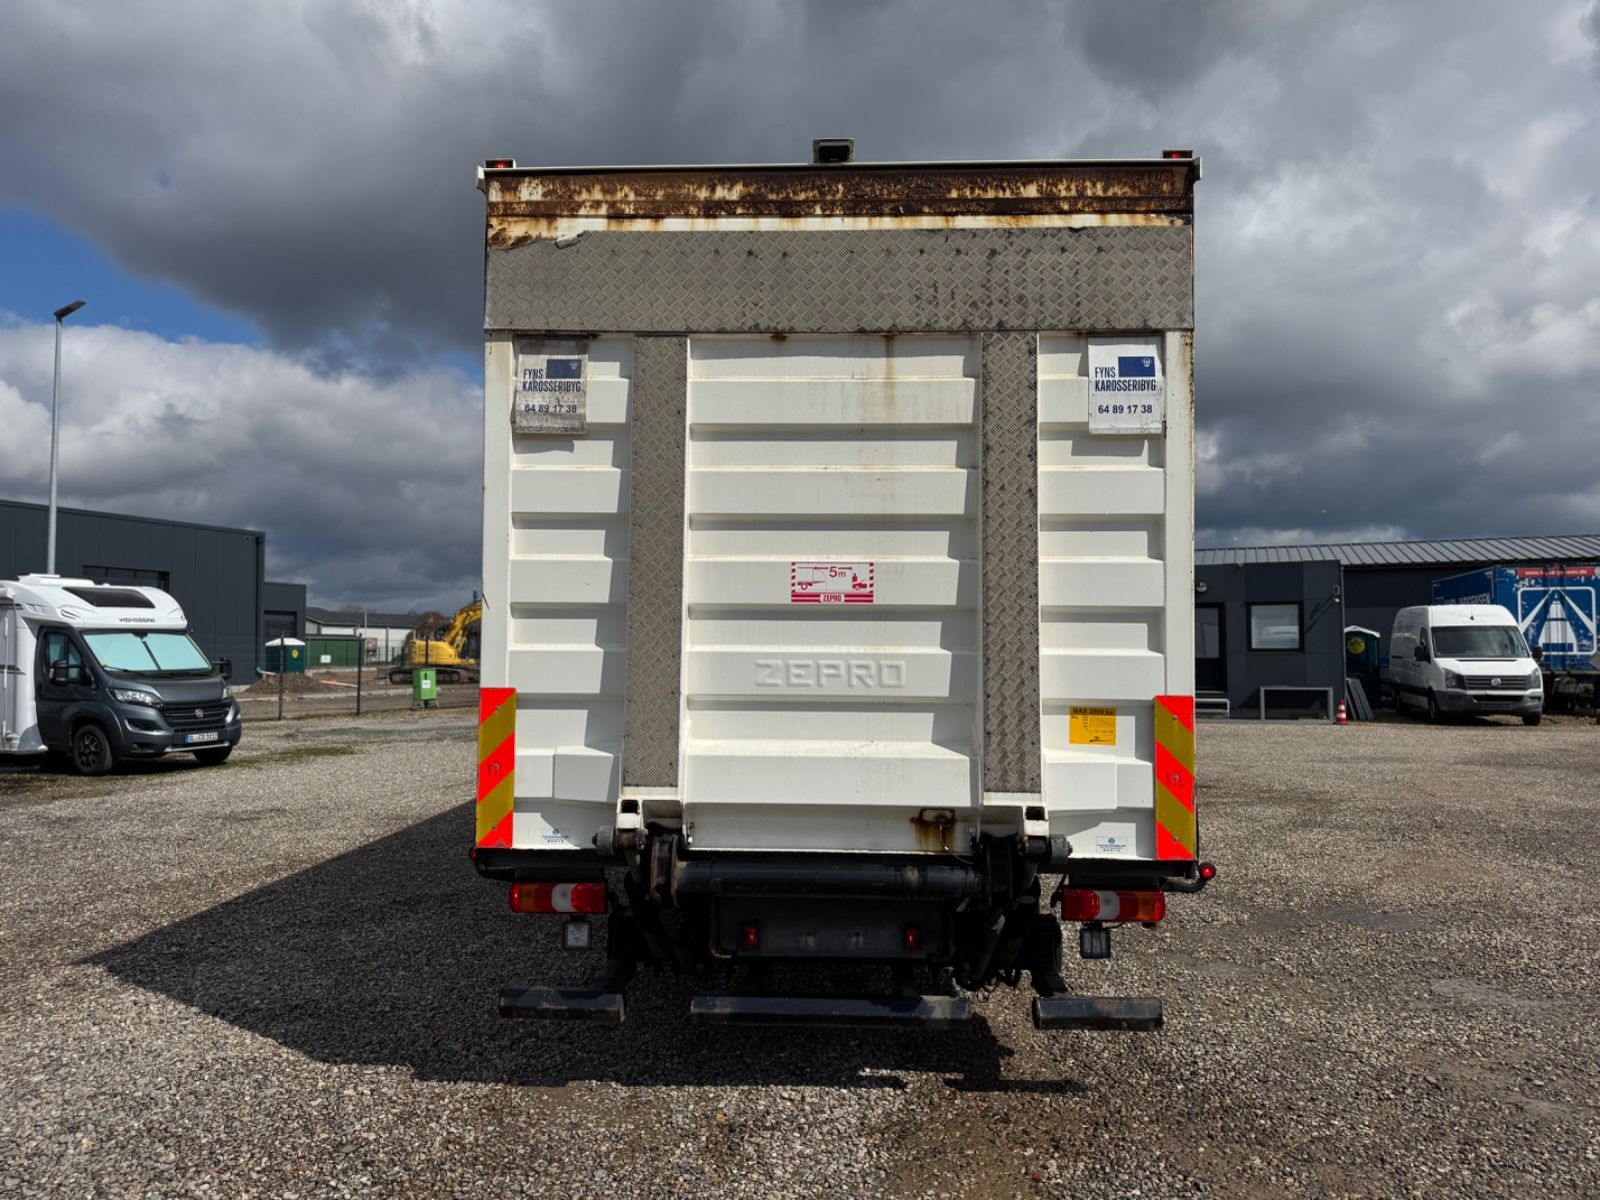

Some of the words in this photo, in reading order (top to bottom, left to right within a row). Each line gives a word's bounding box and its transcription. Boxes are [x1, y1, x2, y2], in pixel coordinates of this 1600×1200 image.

[523, 368, 544, 379] FYNS
[1095, 366, 1116, 378] FYNS
[522, 380, 581, 393] KAROSSERIBYG
[1095, 379, 1156, 392] KAROSSERIBYG
[525, 404, 536, 413] 64
[538, 404, 550, 413] 89
[554, 404, 562, 413] 17
[566, 404, 577, 413] 38
[1098, 405, 1109, 414] 64
[1112, 405, 1124, 414] 89
[1127, 405, 1138, 414] 17
[1141, 405, 1153, 414] 38
[823, 594, 842, 602] ZEPRO
[755, 659, 906, 688] ZEPRO
[1072, 707, 1088, 715] MAX
